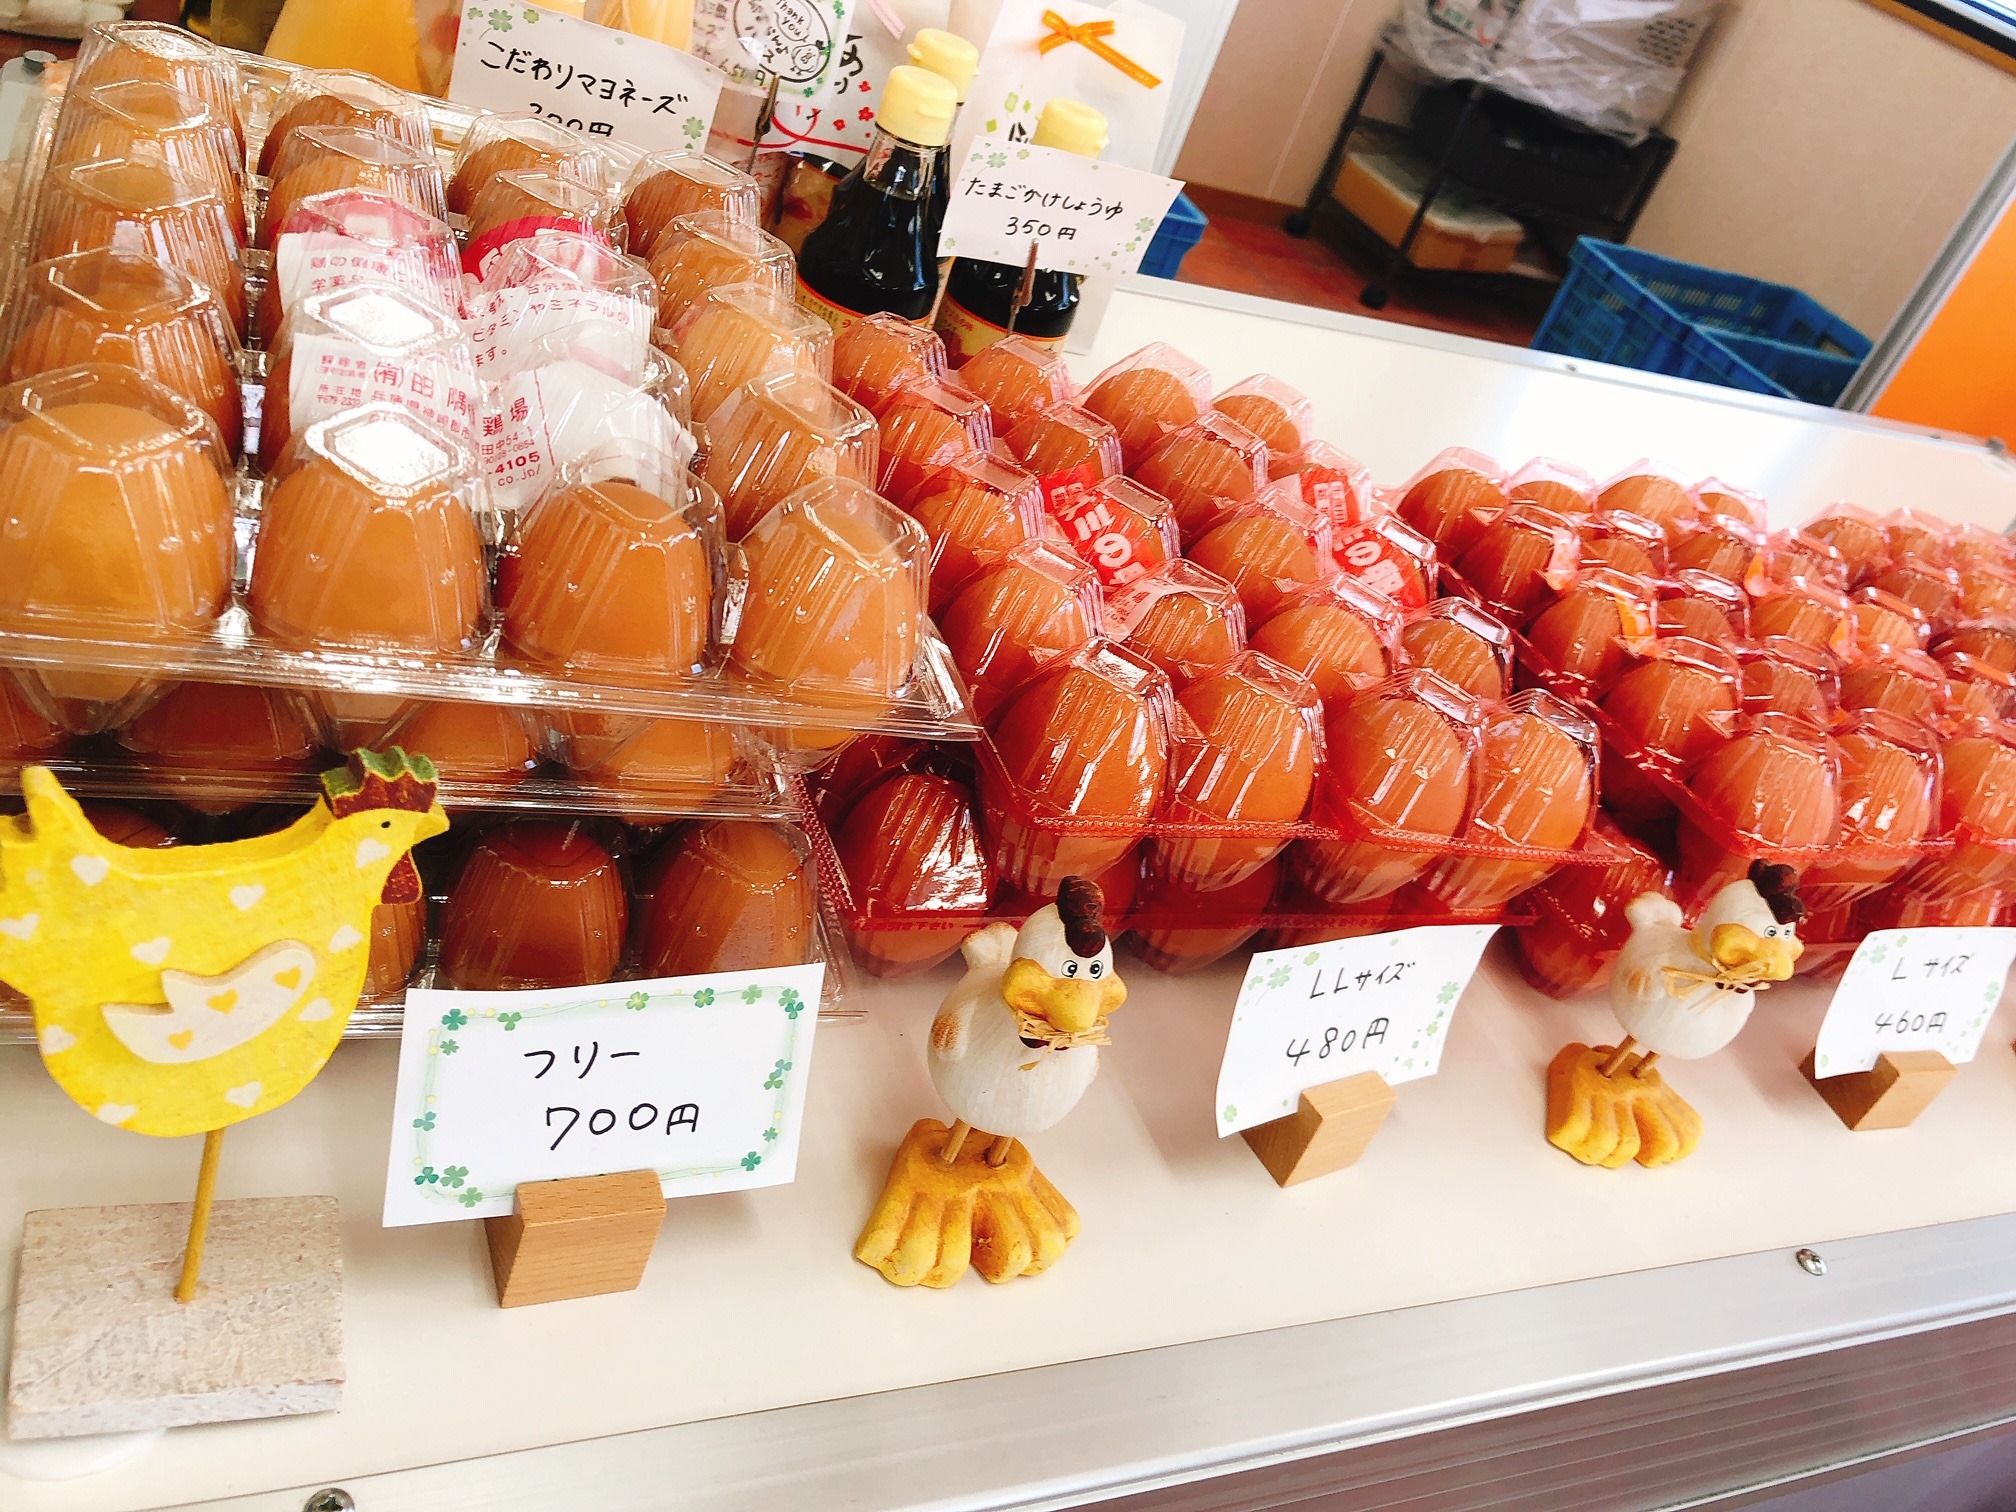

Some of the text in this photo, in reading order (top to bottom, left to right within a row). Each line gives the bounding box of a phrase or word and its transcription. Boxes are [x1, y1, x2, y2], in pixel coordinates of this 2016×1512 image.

[480, 41, 689, 115] こだわりマヨネーズ
[965, 177, 1124, 221] たまごかけしょうゆ
[1005, 216, 1077, 241] 350円
[1286, 1016, 1390, 1067] 480円
[1874, 1009, 1948, 1034] 460円
[523, 1040, 642, 1081] フリー
[545, 1102, 701, 1151] 700円
